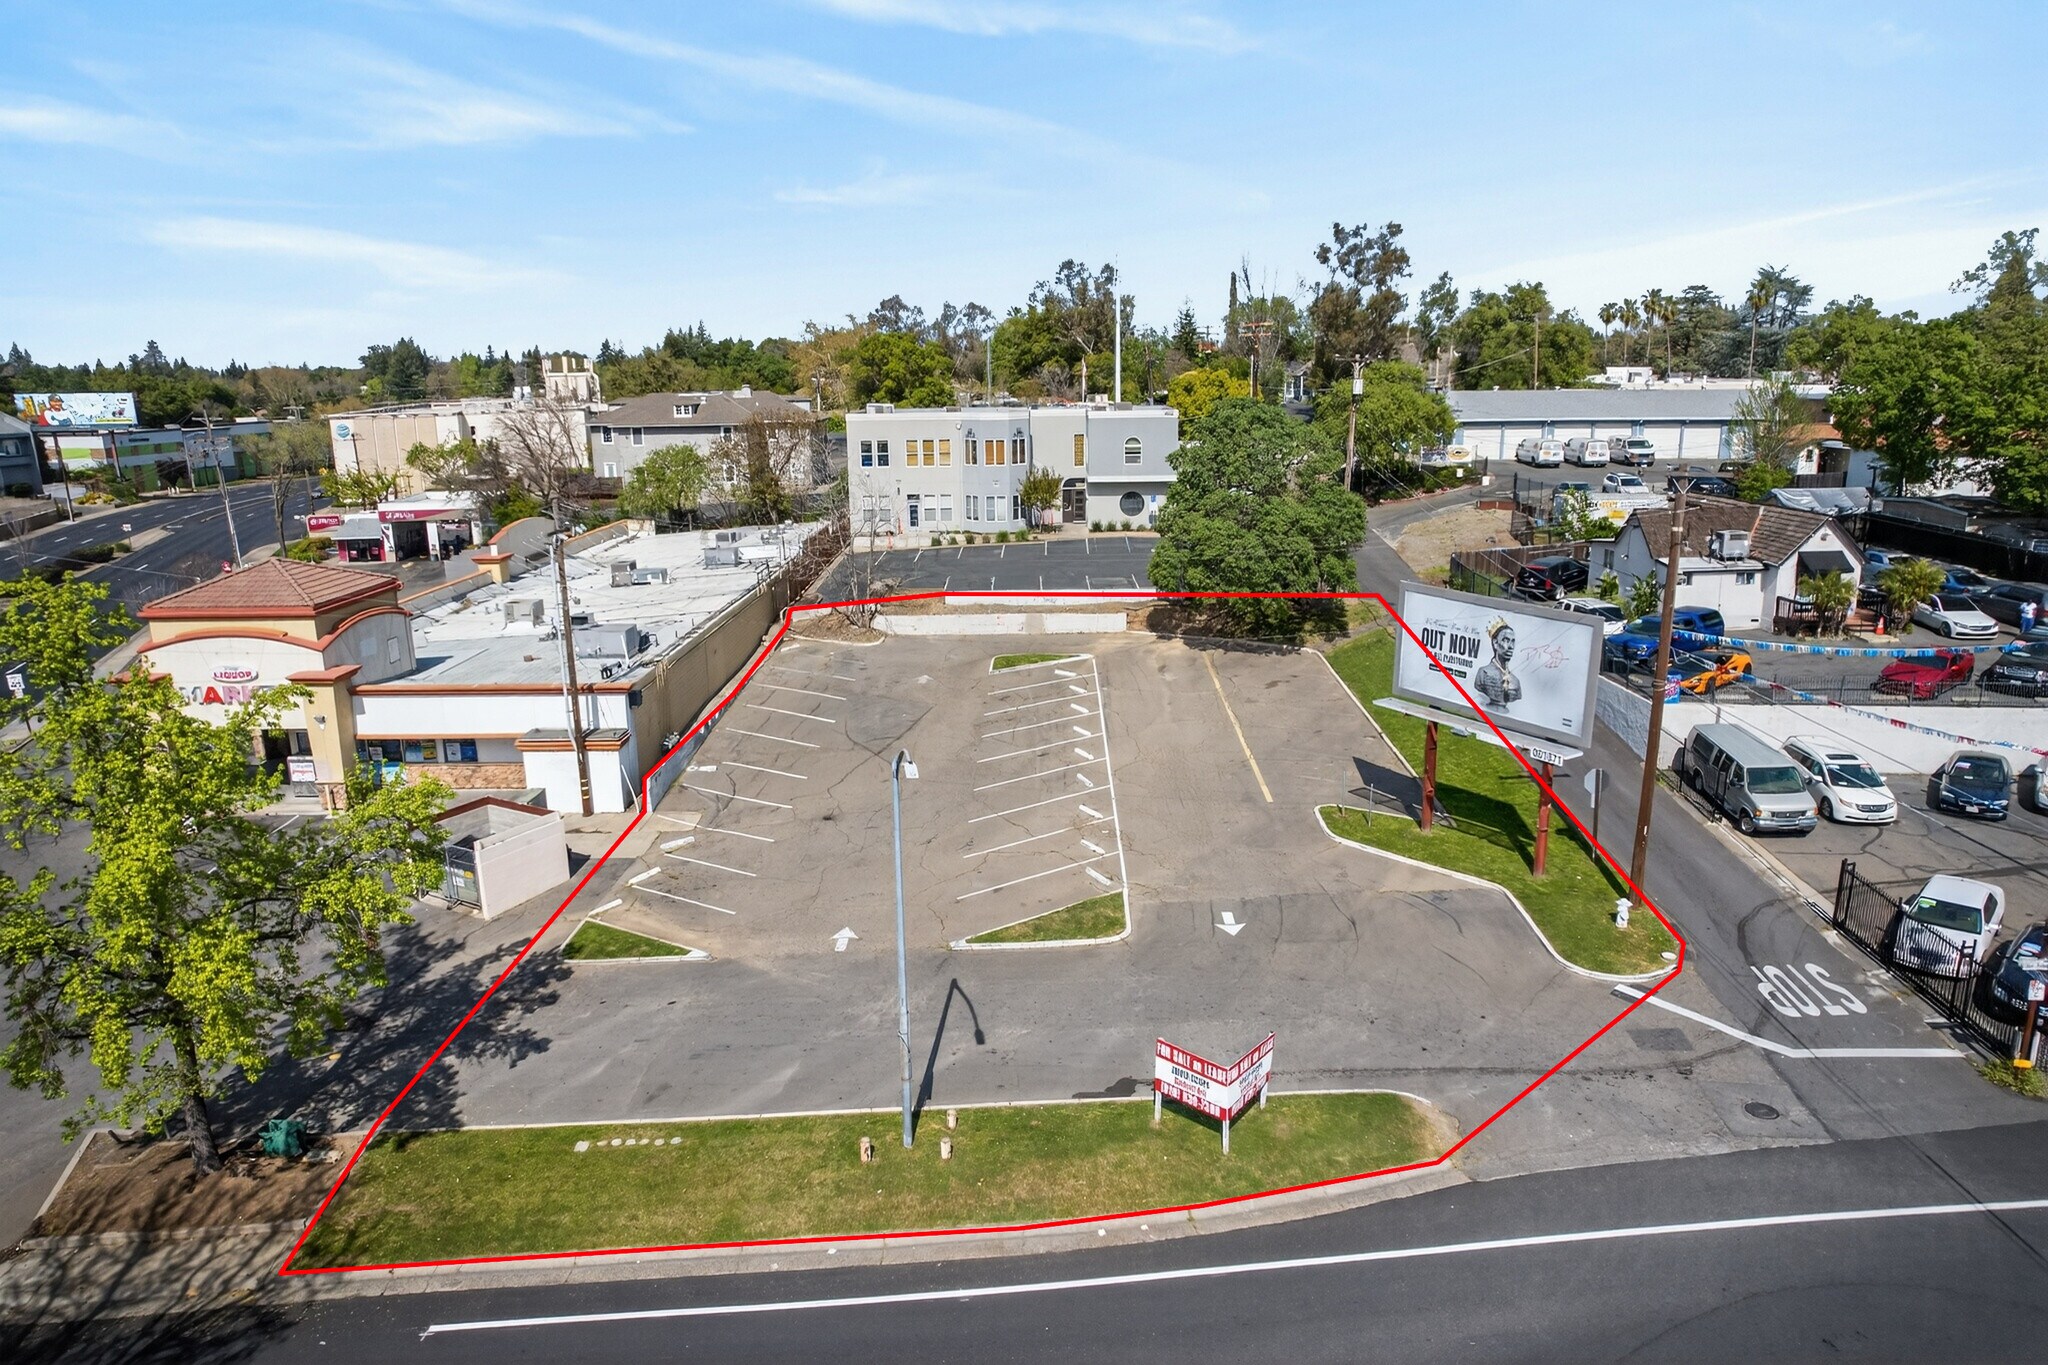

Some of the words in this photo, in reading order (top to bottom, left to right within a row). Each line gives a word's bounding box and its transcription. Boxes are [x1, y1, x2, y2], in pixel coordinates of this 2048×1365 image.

[1421, 627, 1446, 651] OUT
[1448, 633, 1481, 659] NOW
[213, 670, 253, 680] LIQUOR
[1750, 962, 1868, 1017] STOP
